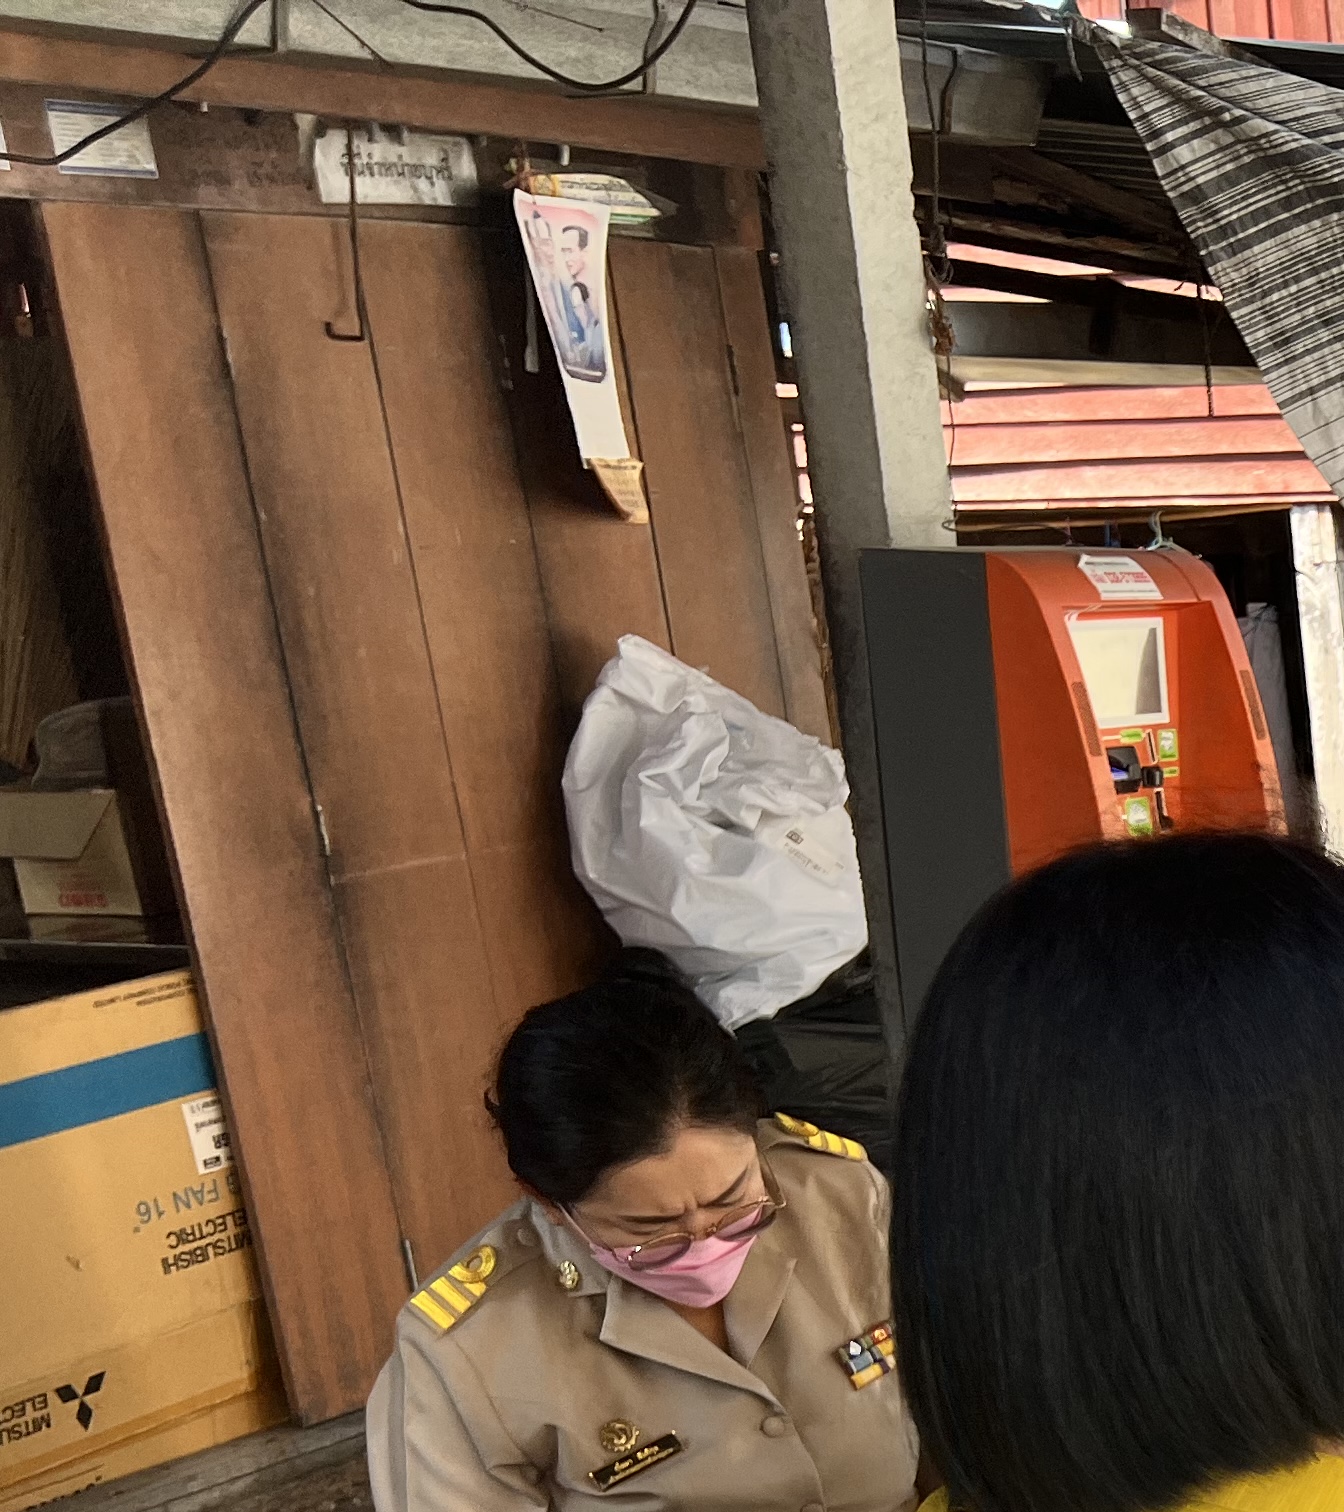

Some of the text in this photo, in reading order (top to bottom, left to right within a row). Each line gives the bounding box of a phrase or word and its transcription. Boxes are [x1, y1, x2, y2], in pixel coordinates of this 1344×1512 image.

[172, 1178, 219, 1213] FAN
[166, 1208, 248, 1249] ELECTRIC
[161, 1228, 252, 1275] MITSUBISHI
[0, 1391, 48, 1425] ELEC
